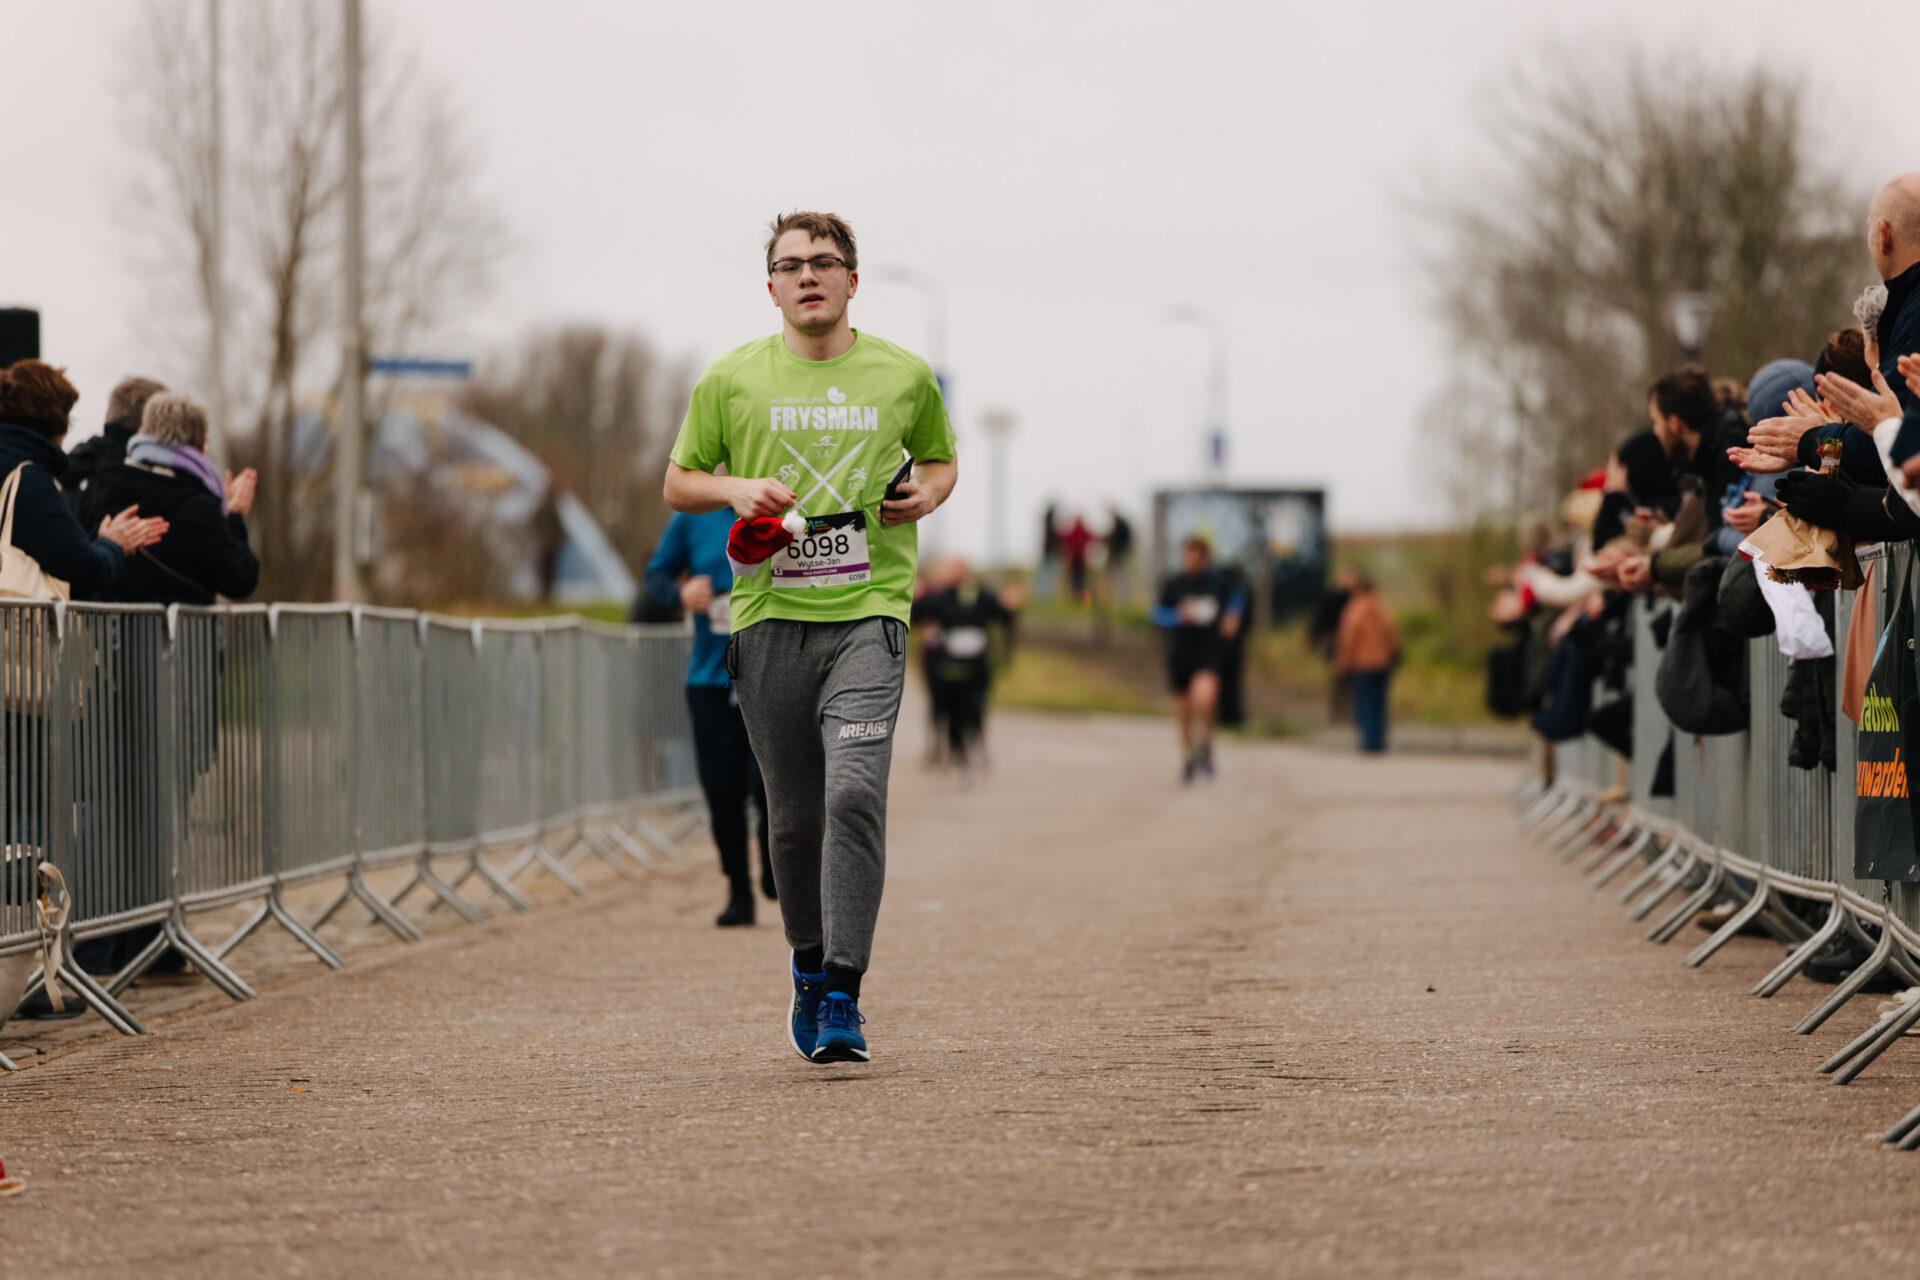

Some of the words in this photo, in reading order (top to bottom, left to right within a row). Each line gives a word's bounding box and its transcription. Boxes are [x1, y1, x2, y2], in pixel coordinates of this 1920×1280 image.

[770, 406, 878, 431] FRYSMAN
[787, 534, 849, 559] 6098
[797, 558, 841, 570] Wytse-Jan
[848, 573, 866, 581] 6098
